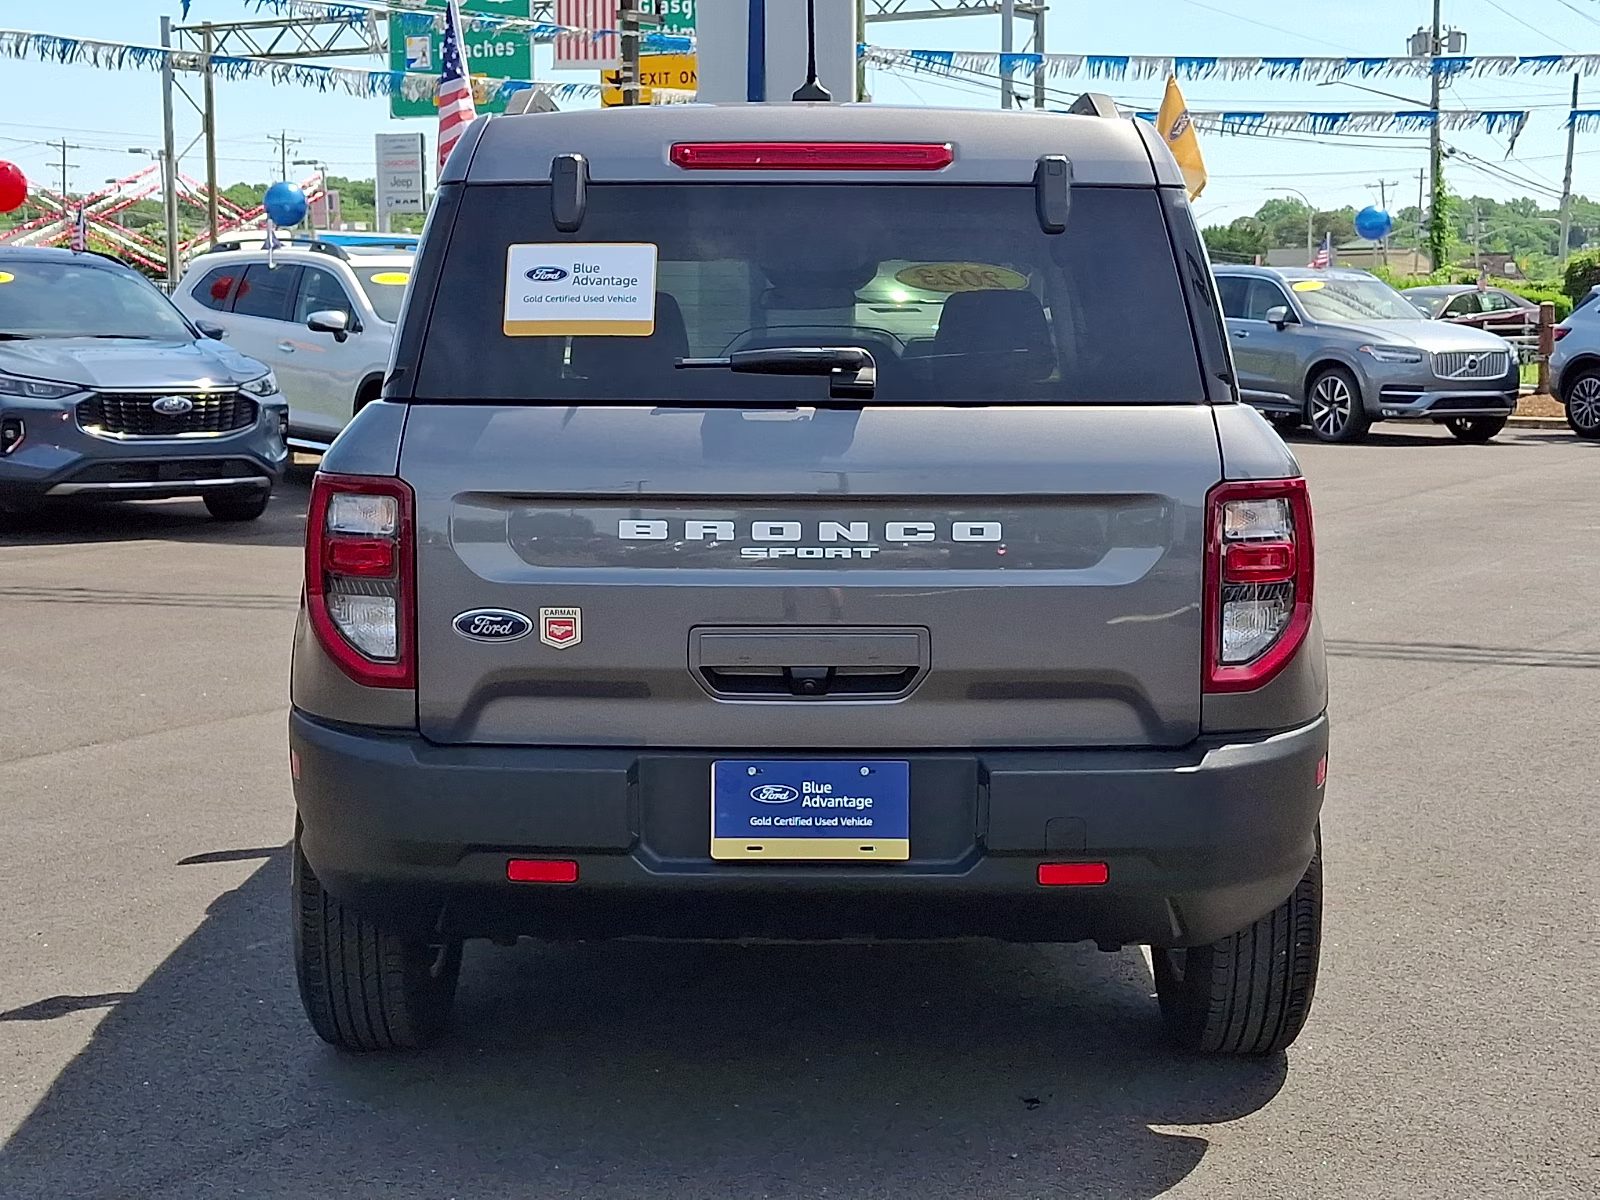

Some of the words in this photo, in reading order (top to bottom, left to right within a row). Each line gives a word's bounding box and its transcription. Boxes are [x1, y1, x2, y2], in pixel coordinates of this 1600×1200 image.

[638, 0, 697, 19] Glasg
[640, 72, 670, 86] EXIT
[390, 176, 413, 189] Jeep
[573, 263, 600, 273] Blue
[572, 276, 638, 288] Advantage
[523, 295, 543, 303] Gold
[545, 295, 581, 303] Certified
[583, 295, 605, 303] Used
[607, 295, 637, 303] Vehicle
[618, 519, 1002, 542] BRONCO
[740, 547, 880, 559] SPORT
[470, 615, 514, 635] Ford
[802, 781, 832, 794] Blue
[802, 796, 873, 810] Advantage
[750, 817, 772, 826] Gold
[773, 816, 813, 826] Certified
[814, 817, 839, 826] Used
[840, 816, 873, 826] Vehicle
